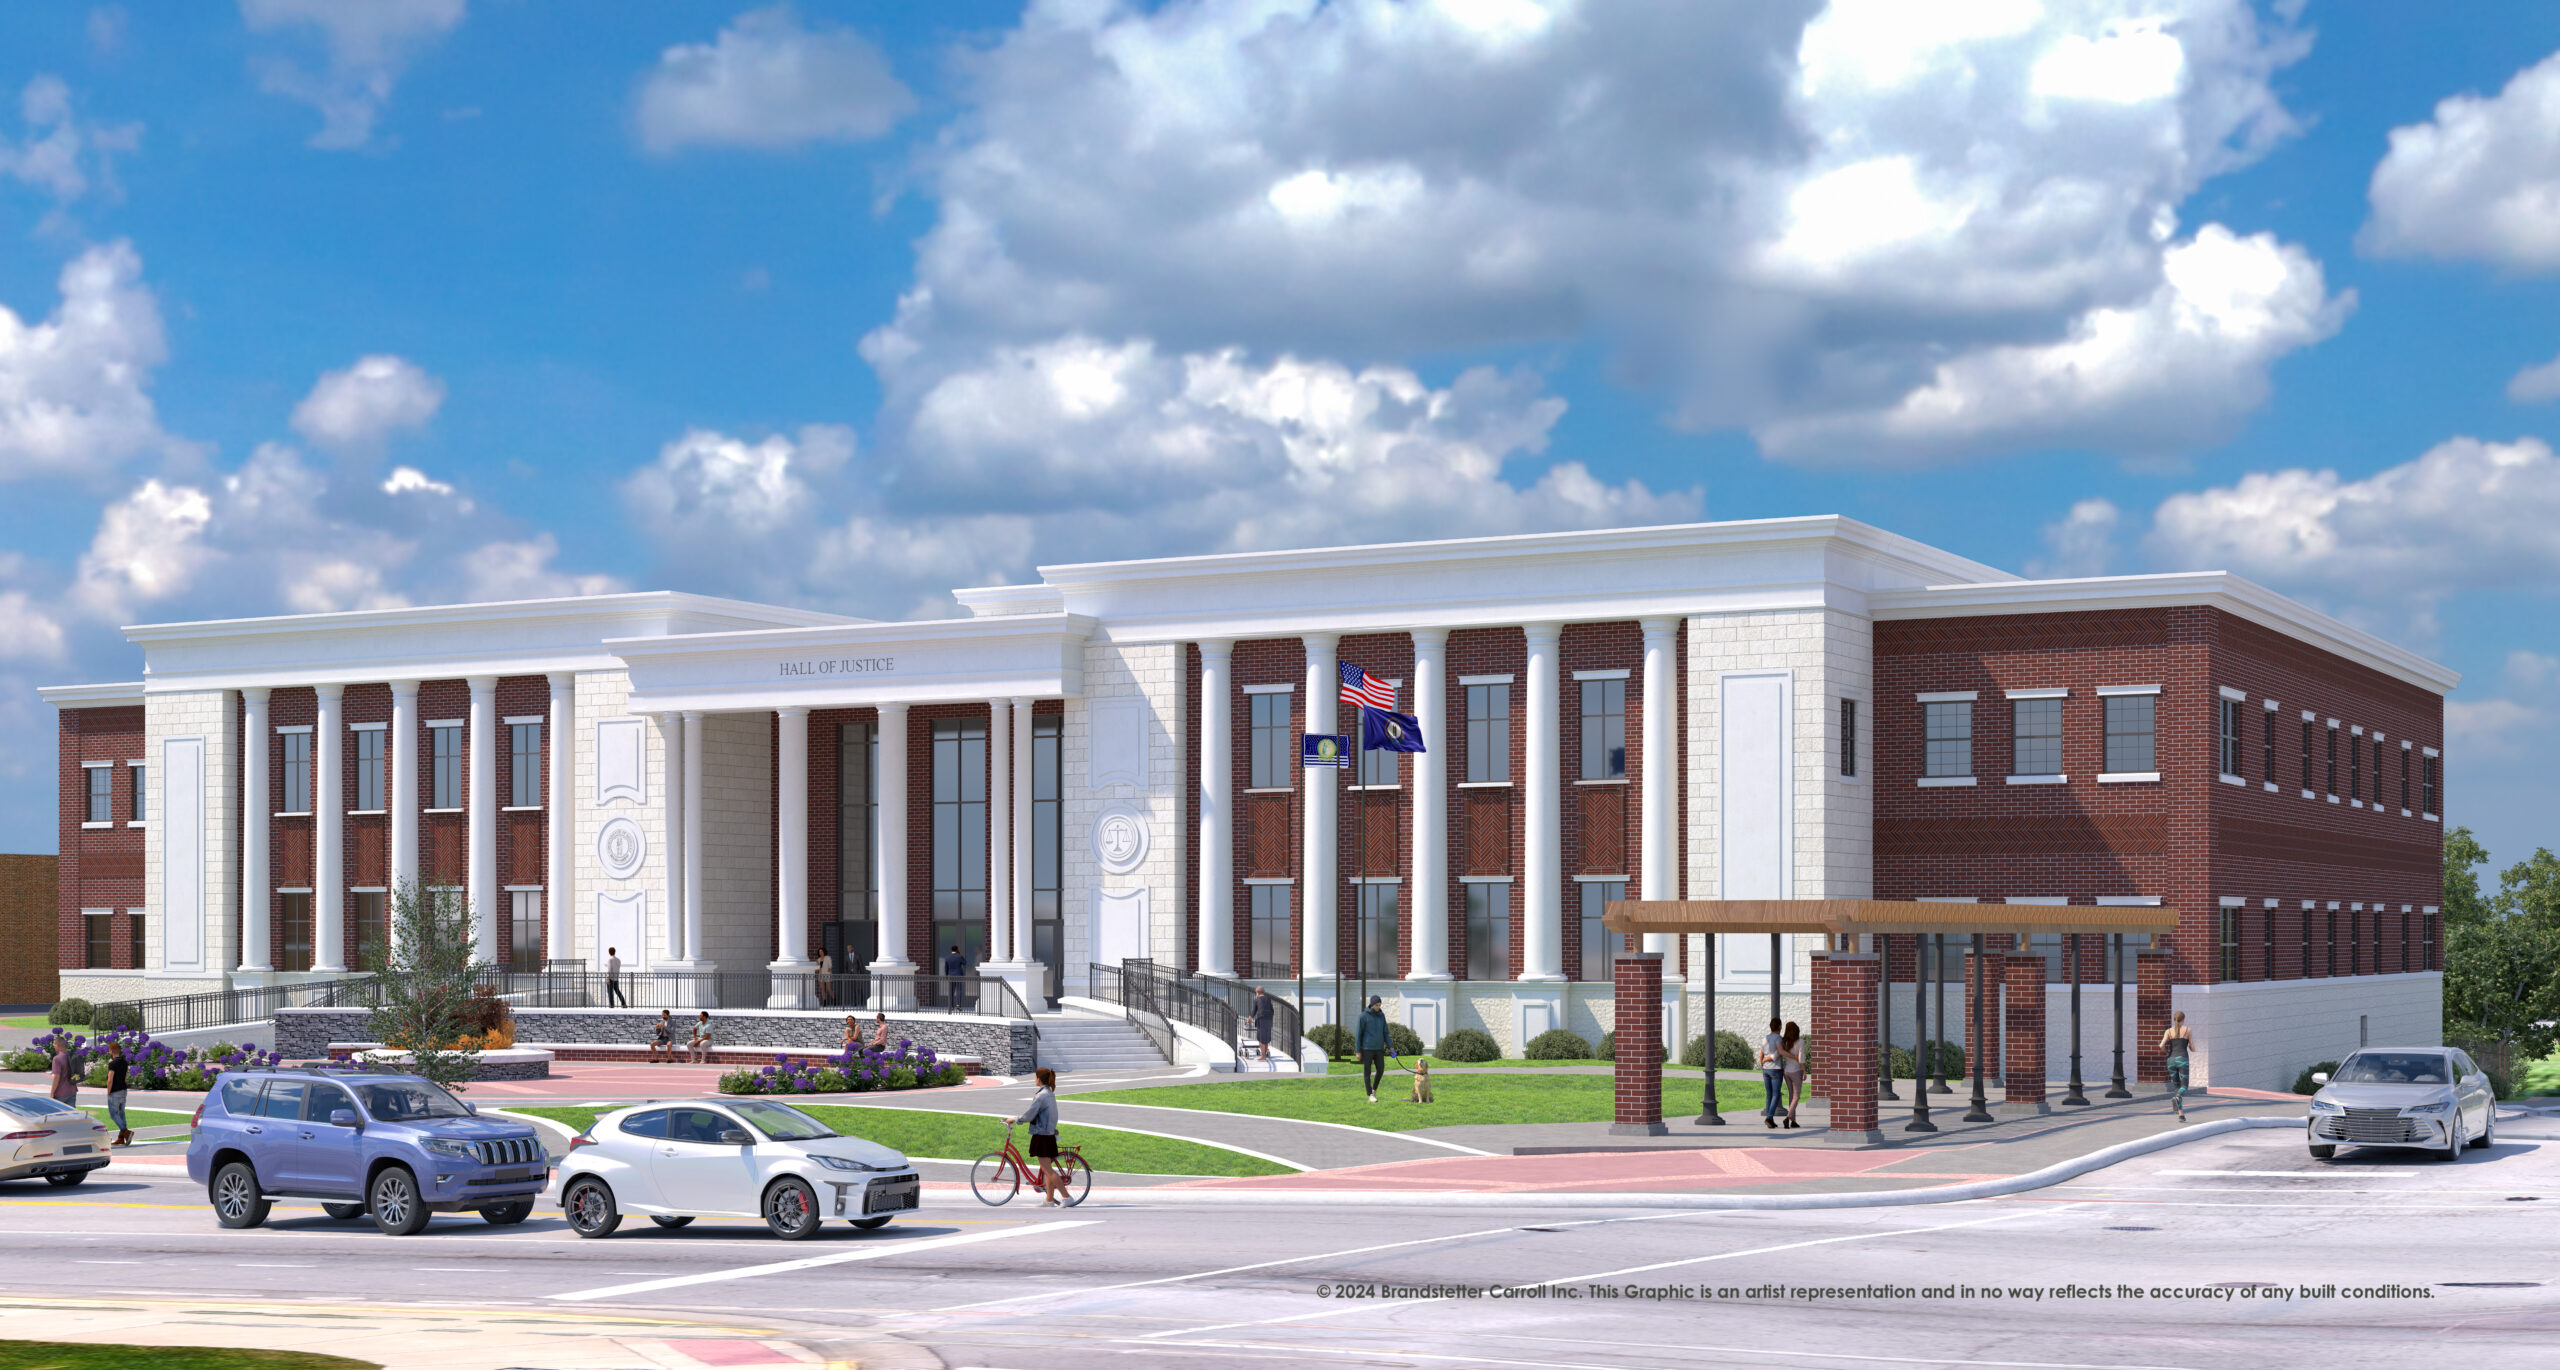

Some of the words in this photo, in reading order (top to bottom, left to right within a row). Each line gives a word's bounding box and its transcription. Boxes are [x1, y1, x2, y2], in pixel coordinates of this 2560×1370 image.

[780, 662, 815, 676] HALL
[818, 660, 837, 674] OF
[839, 657, 895, 673] JUSTICE
